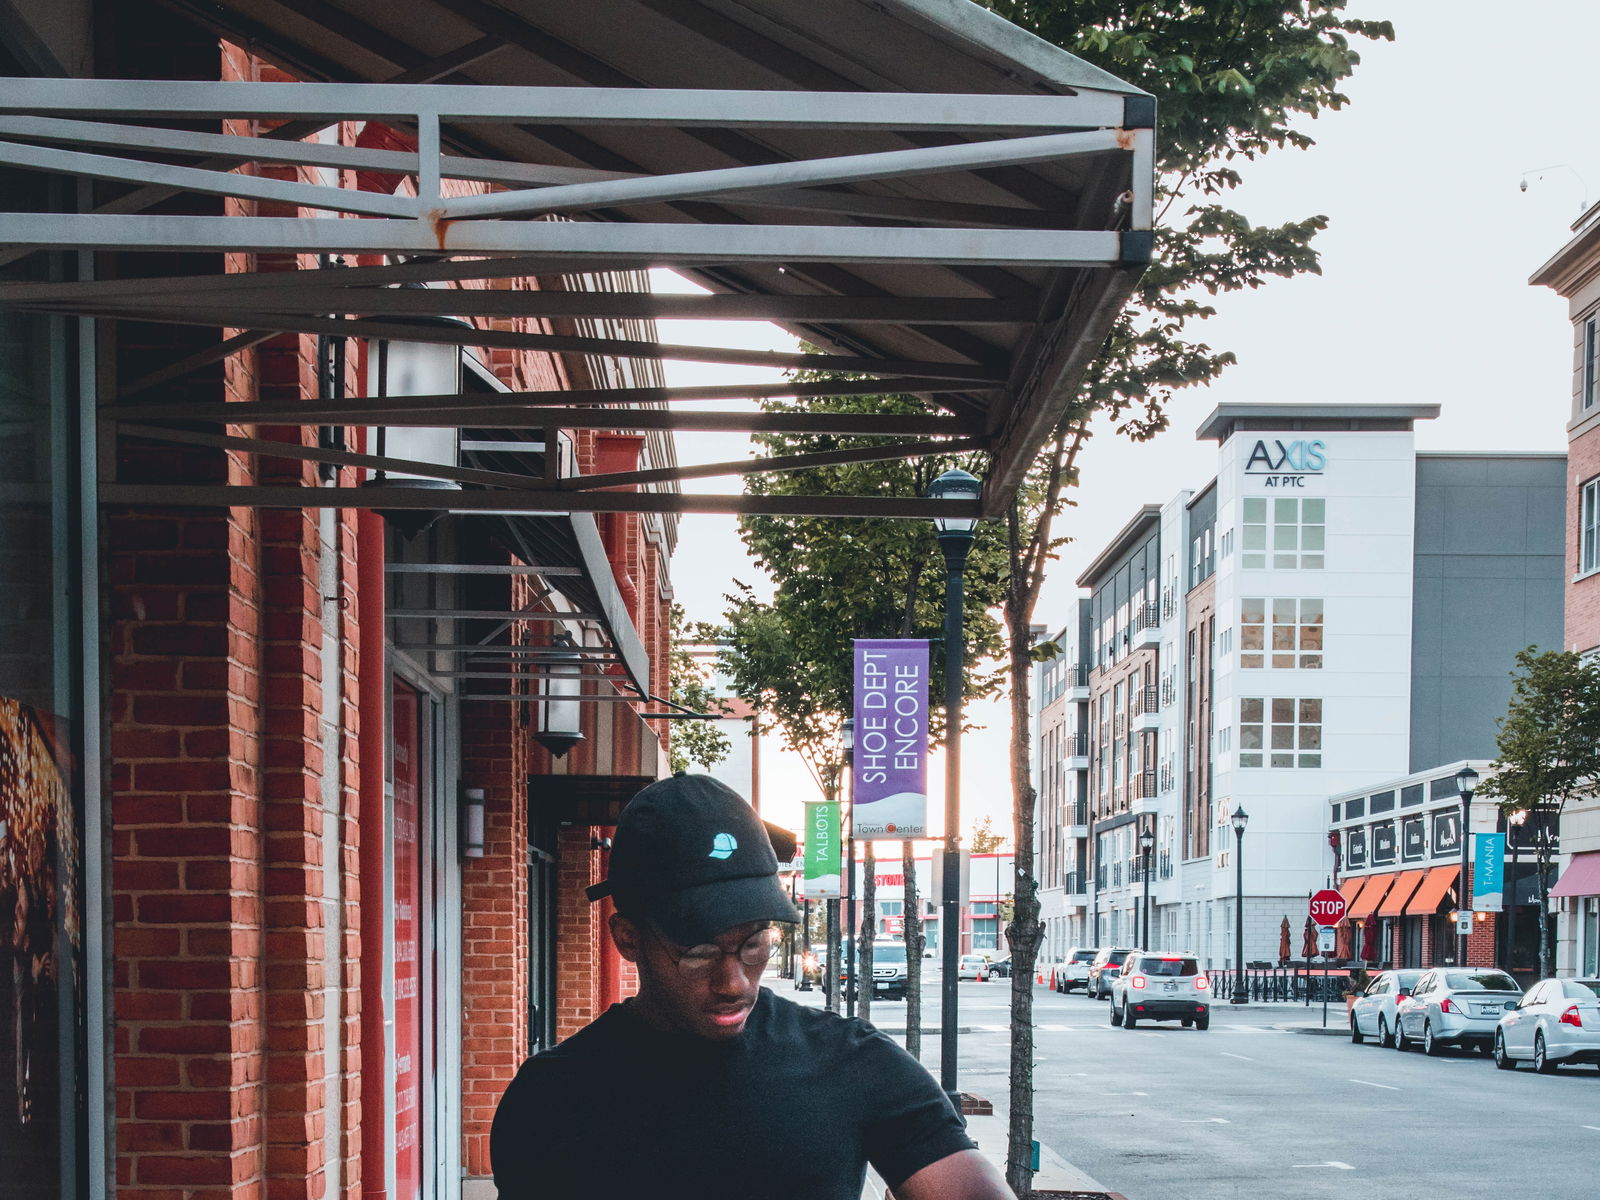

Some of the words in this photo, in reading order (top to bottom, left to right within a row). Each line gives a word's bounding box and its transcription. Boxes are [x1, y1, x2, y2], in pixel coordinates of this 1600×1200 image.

[1245, 440, 1326, 470] AXIS
[1265, 476, 1279, 487] AT
[1282, 476, 1304, 487] PTC
[863, 651, 887, 709] DEPT
[894, 665, 918, 769] ENCORE
[863, 717, 887, 784] SHOE
[816, 805, 829, 862] TALBOTS
[857, 823, 884, 834] Town
[1484, 837, 1495, 886] T-MANIA
[1311, 901, 1344, 915] STOP
